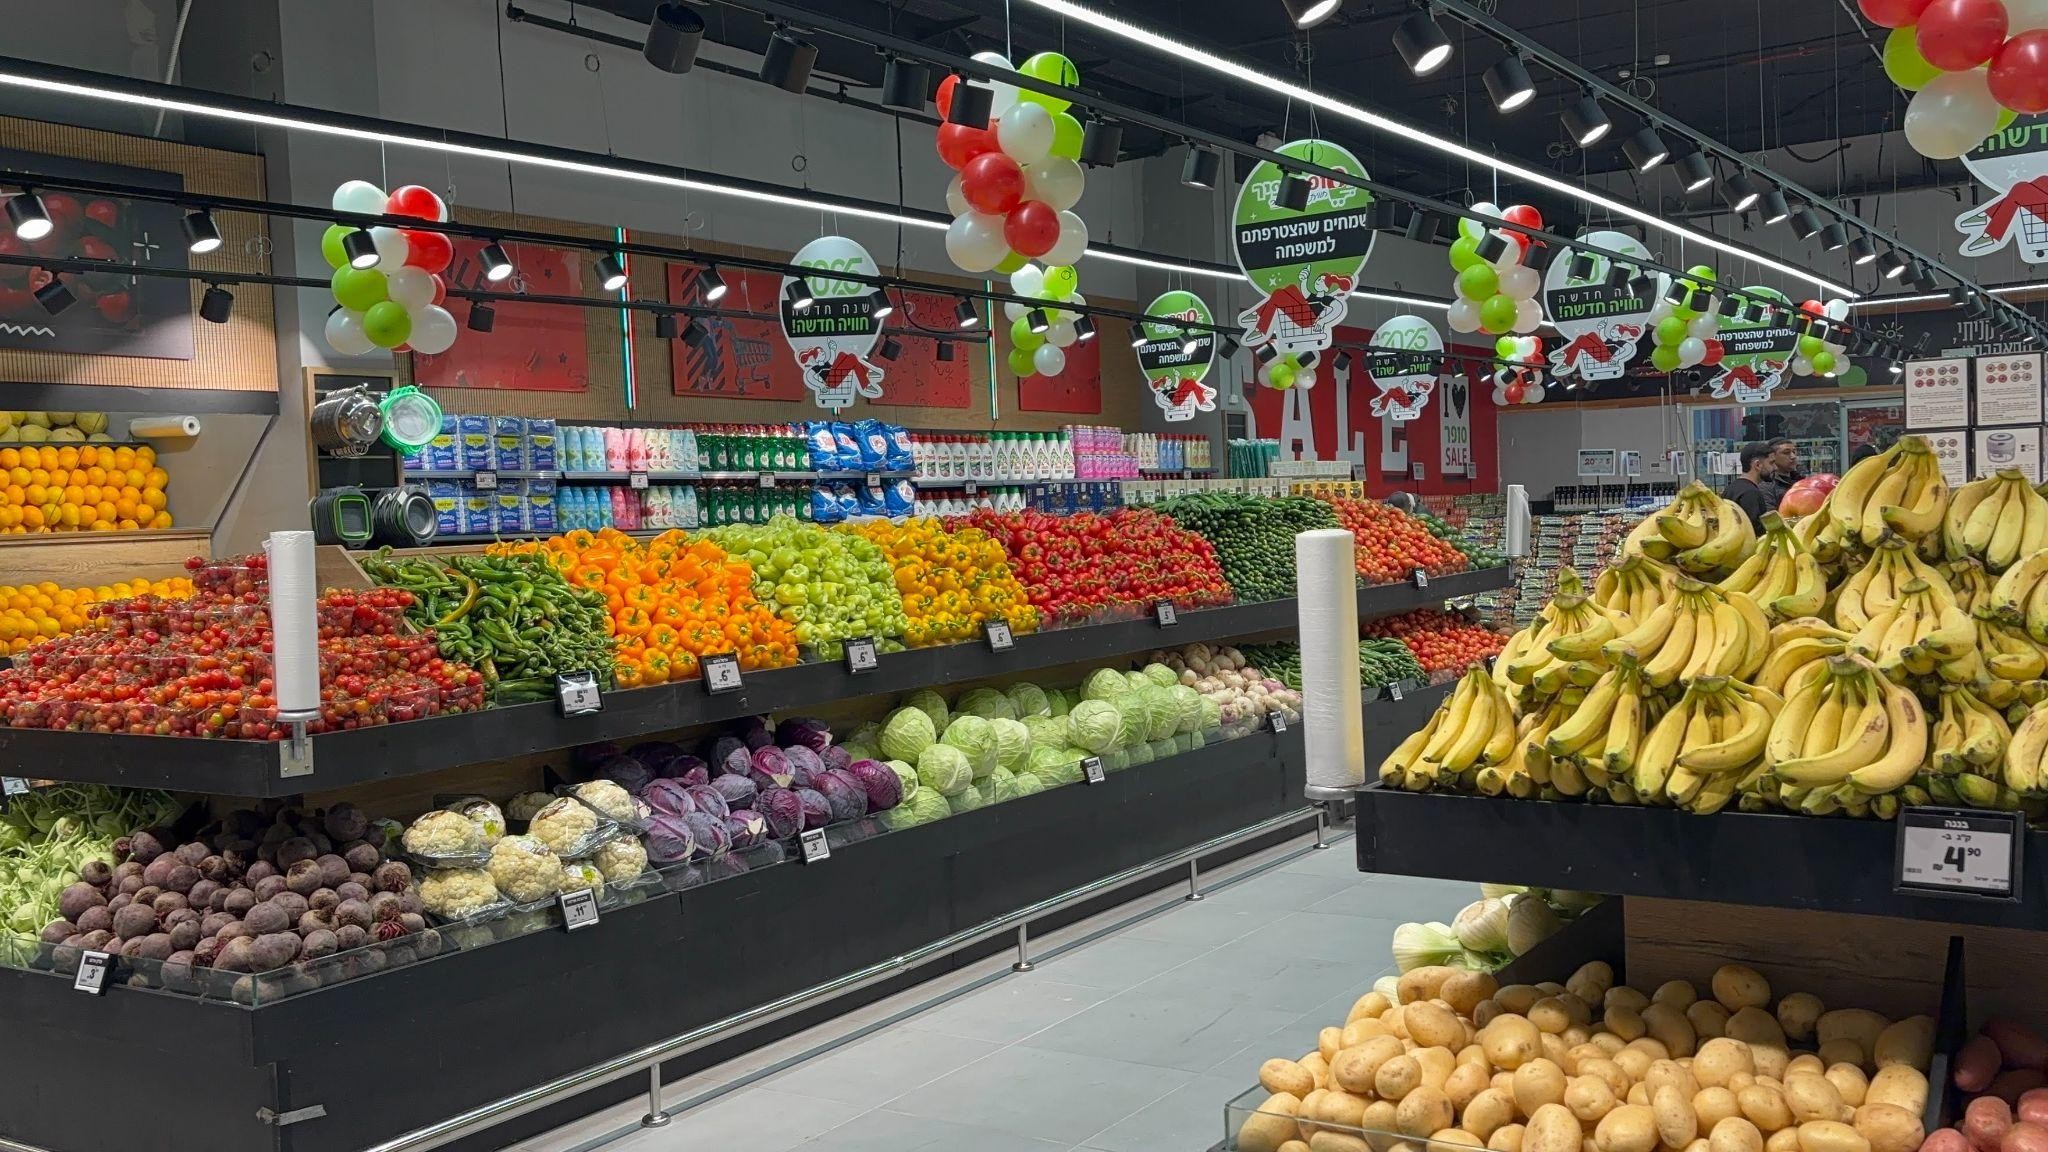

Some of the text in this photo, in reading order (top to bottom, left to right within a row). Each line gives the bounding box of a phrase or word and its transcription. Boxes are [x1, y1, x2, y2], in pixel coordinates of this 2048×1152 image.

[1978, 123, 2048, 153] דשה
[1241, 214, 1366, 244] שמחים שהצטרפתם
[1275, 236, 1336, 259] למשפחה
[1558, 290, 1602, 304] חדשה
[792, 303, 870, 317] שנה חדשה
[1558, 297, 1643, 318] חוויה חדשה!
[792, 316, 869, 334] חוויה חדשה!
[1766, 328, 1796, 338] שמחים
[1140, 341, 1181, 354] הצטרפתם
[1735, 339, 1774, 351] למשפחה
[1376, 365, 1395, 377] שה!
[1443, 383, 1449, 418] I
[1444, 426, 1467, 443] סופר
[1445, 447, 1468, 466] SALE
[721, 670, 728, 682] 6
[1945, 819, 1969, 829] בננה
[1944, 846, 1965, 873] 4
[1968, 847, 1981, 857] 90
